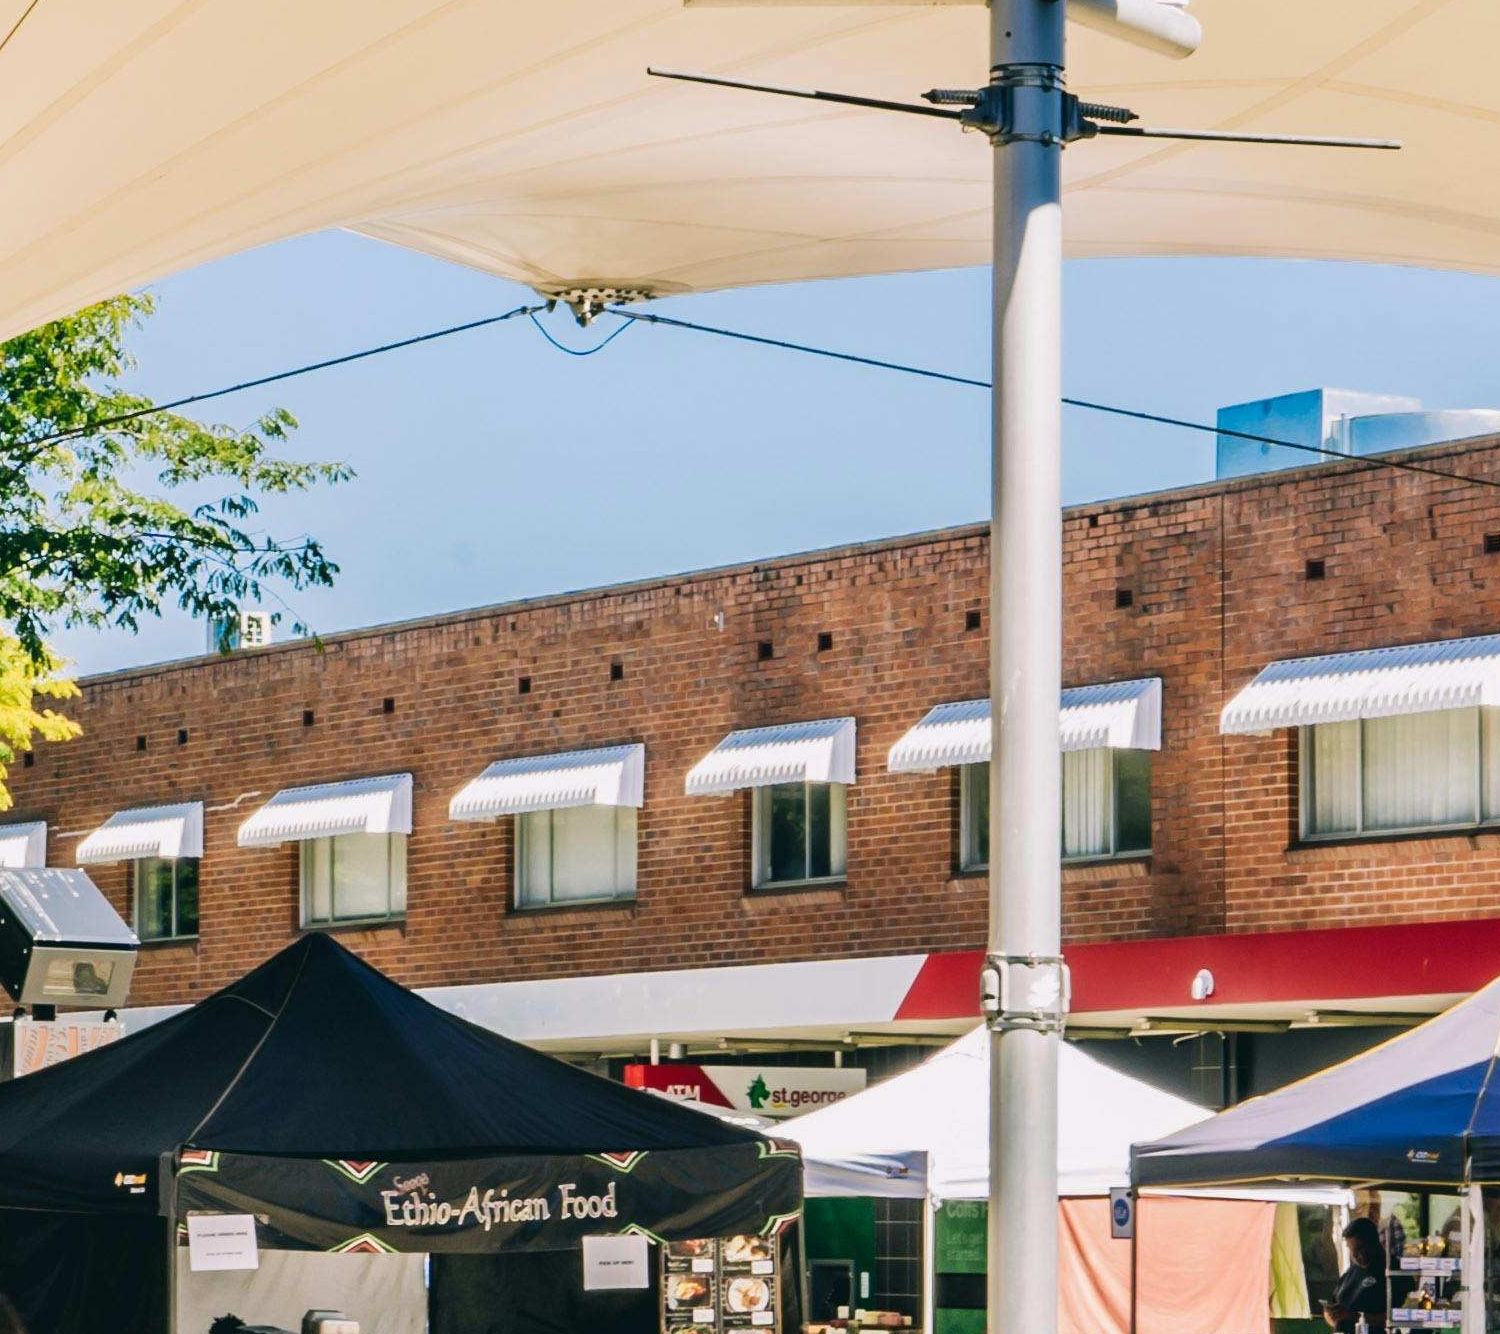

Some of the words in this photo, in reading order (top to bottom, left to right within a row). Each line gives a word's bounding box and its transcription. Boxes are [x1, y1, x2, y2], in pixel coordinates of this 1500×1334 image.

[667, 1083, 700, 1101] ATM
[381, 1186, 551, 1231] Ethio-African
[558, 1181, 618, 1219] Food
